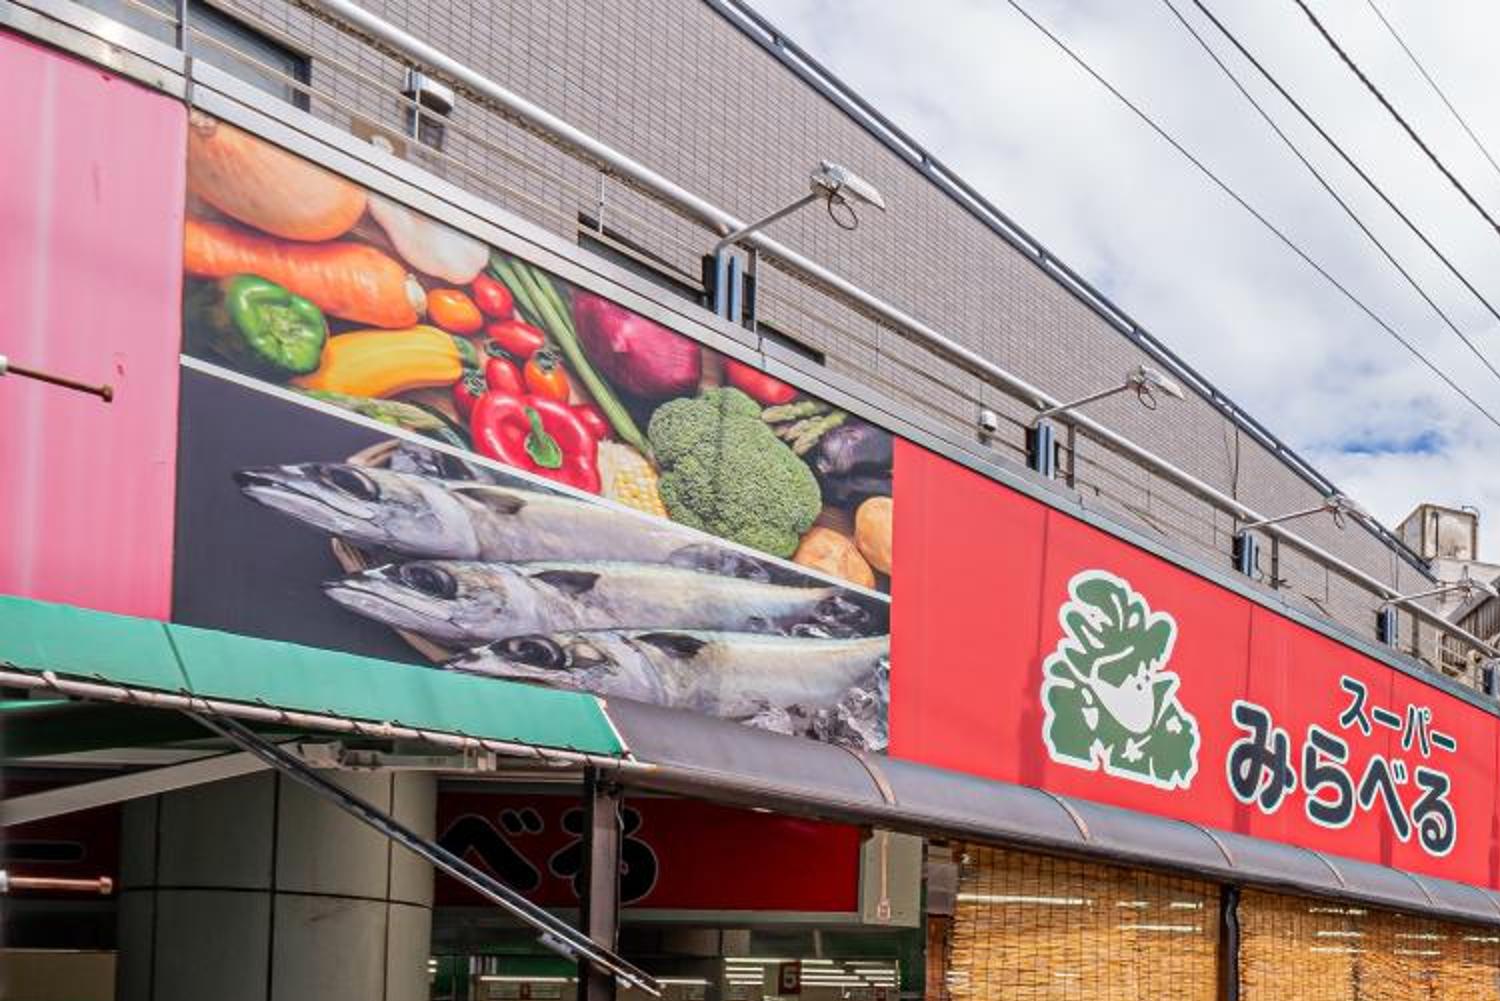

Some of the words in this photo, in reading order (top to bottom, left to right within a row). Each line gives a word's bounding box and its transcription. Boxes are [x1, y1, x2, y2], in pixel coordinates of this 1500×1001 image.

[1339, 675, 1456, 753] スーパー
[1227, 700, 1456, 857] みらべる
[437, 807, 658, 903] べる
